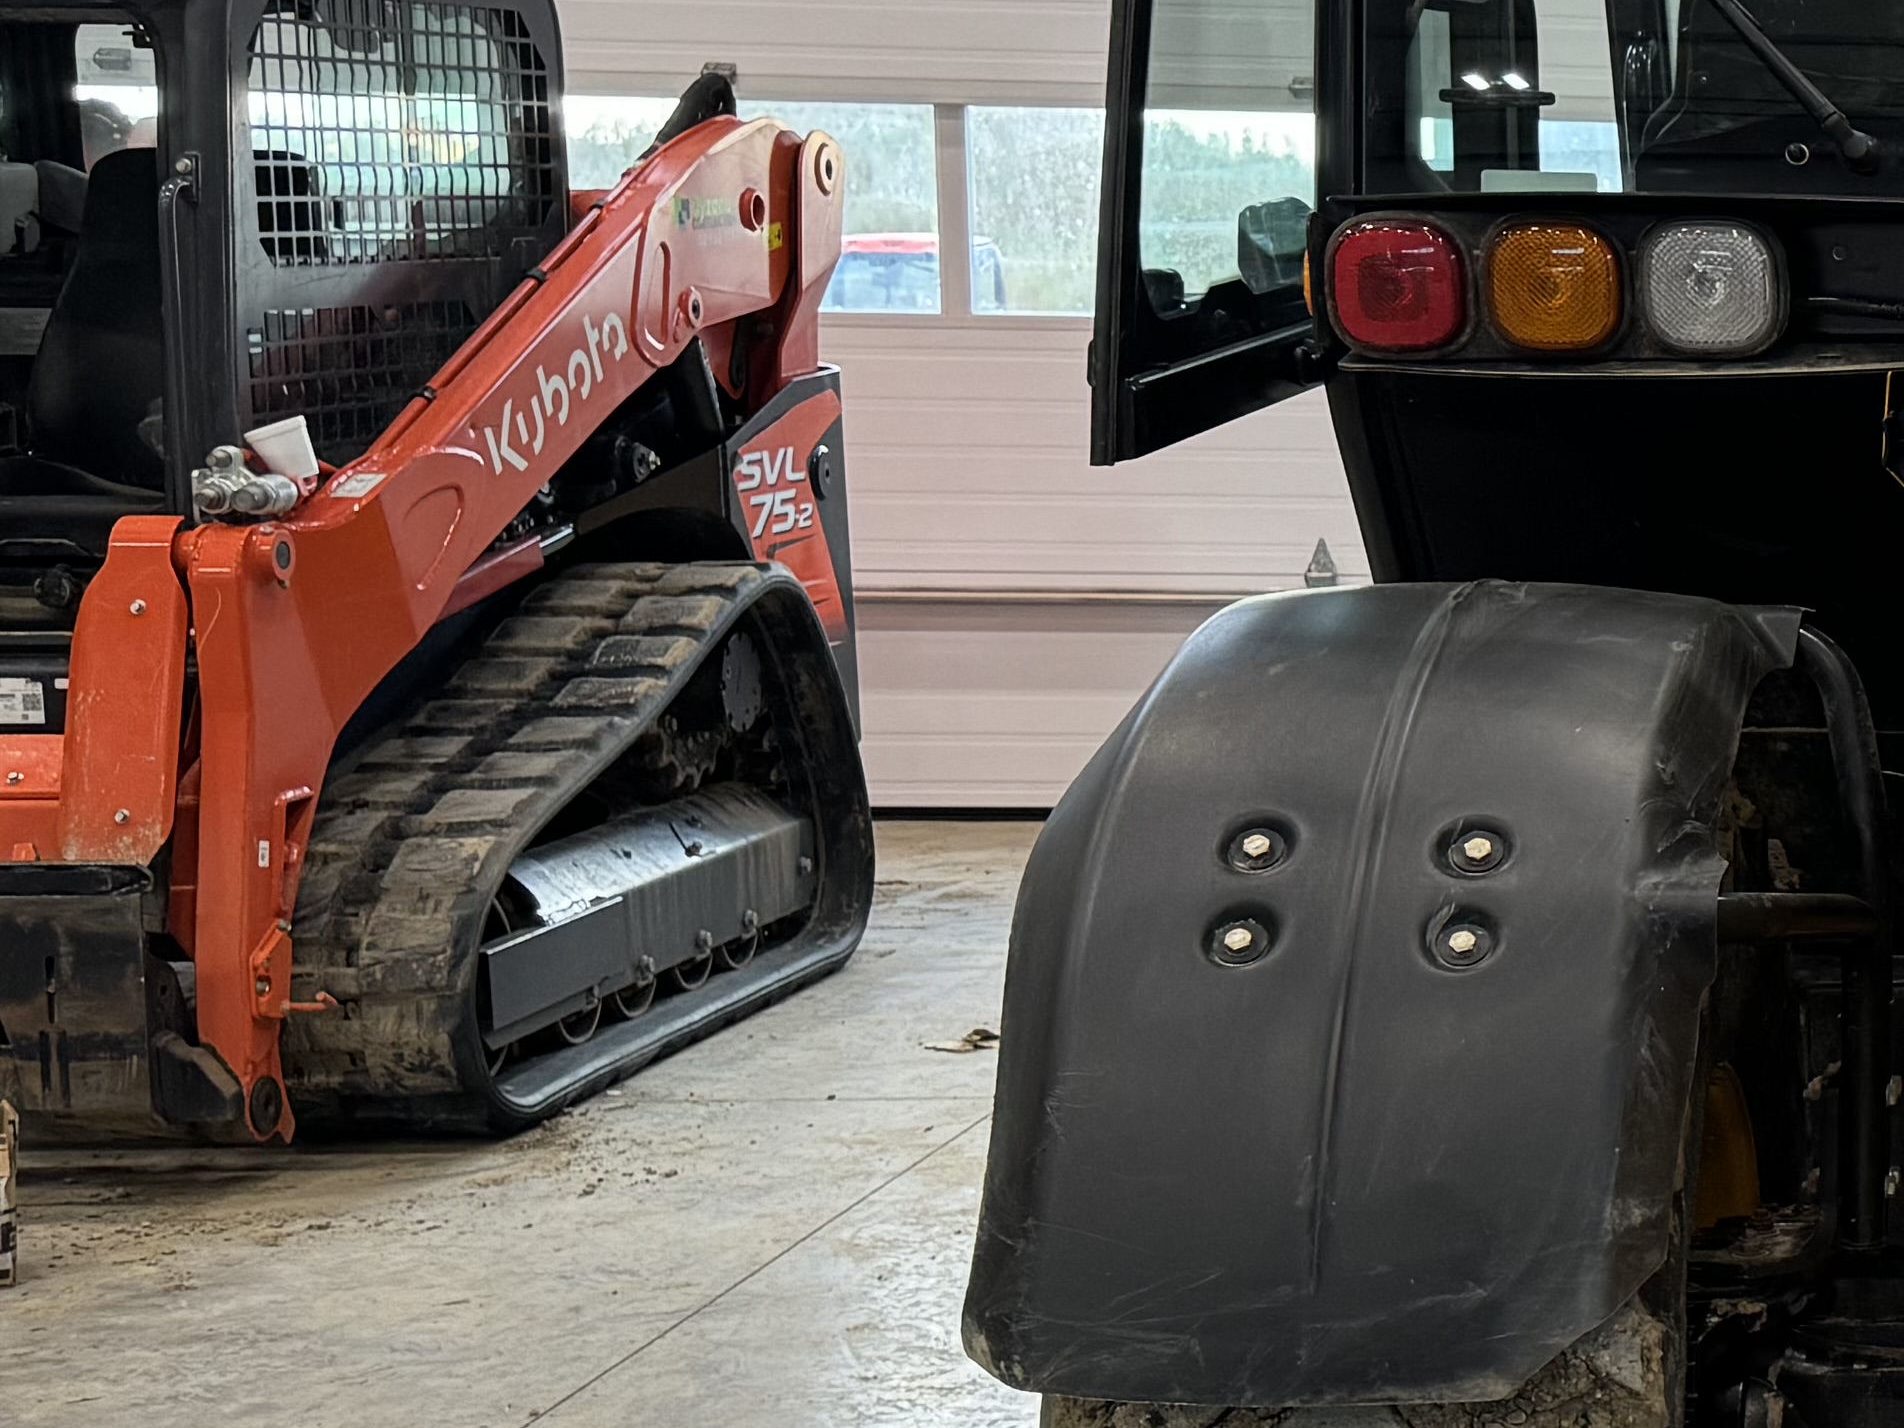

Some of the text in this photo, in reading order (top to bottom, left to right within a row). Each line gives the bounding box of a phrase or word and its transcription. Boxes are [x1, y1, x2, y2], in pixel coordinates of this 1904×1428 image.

[483, 312, 628, 476] Kubota
[737, 446, 806, 491] SVL
[750, 488, 813, 539] 75-2
